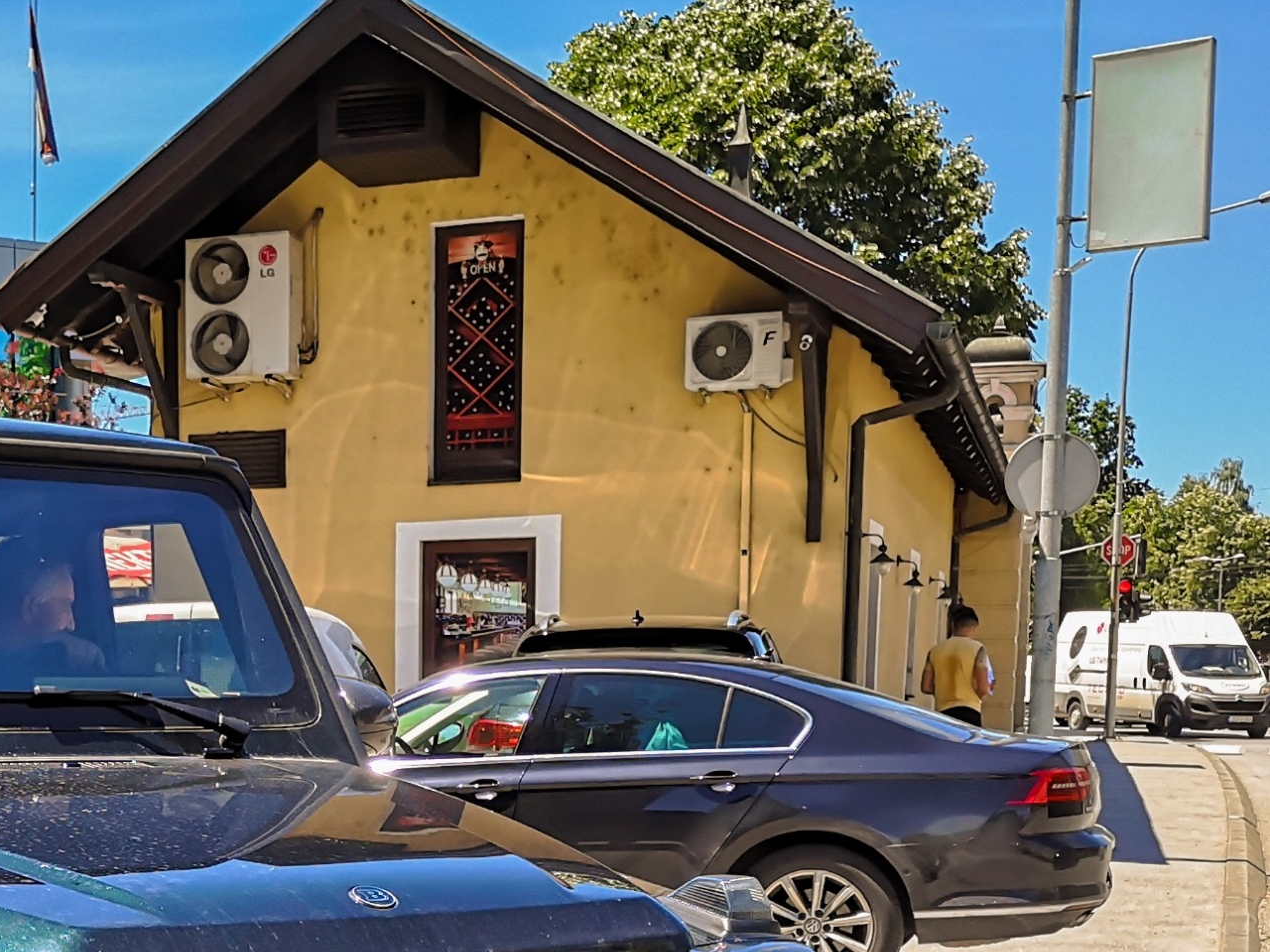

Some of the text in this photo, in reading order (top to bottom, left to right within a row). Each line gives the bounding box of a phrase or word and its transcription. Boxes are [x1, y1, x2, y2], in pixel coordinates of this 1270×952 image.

[260, 267, 275, 278] LG
[470, 261, 496, 275] OPEN
[763, 330, 777, 346] F
